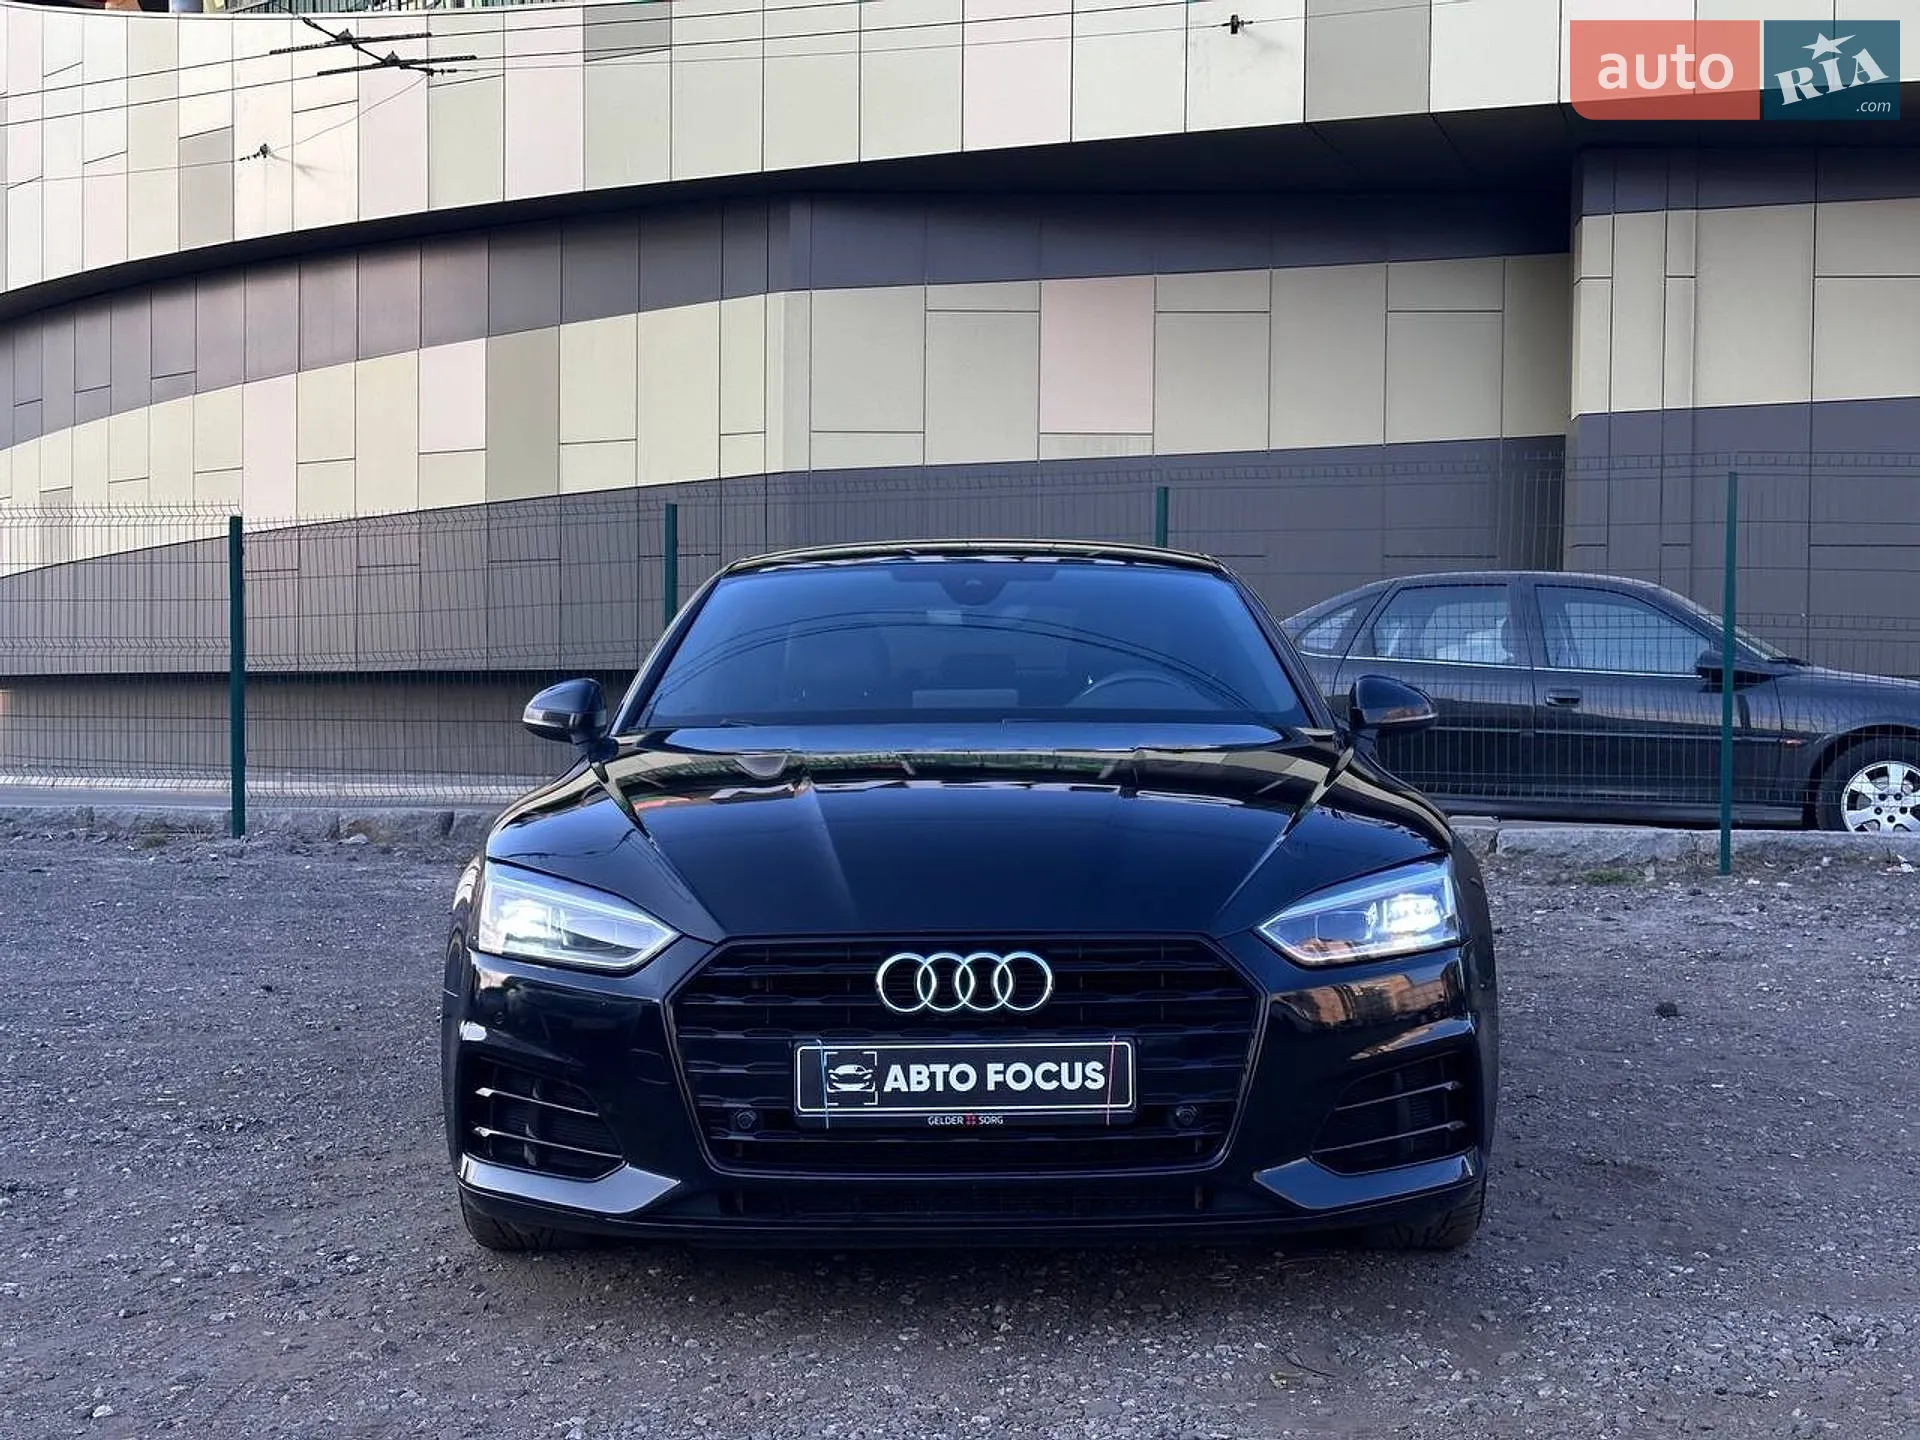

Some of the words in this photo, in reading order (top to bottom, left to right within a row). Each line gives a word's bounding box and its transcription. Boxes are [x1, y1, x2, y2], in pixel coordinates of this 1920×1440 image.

[986, 1061, 1106, 1092] FOCUS
[927, 1115, 964, 1126] GELDER
[978, 1115, 1004, 1125] SORG
